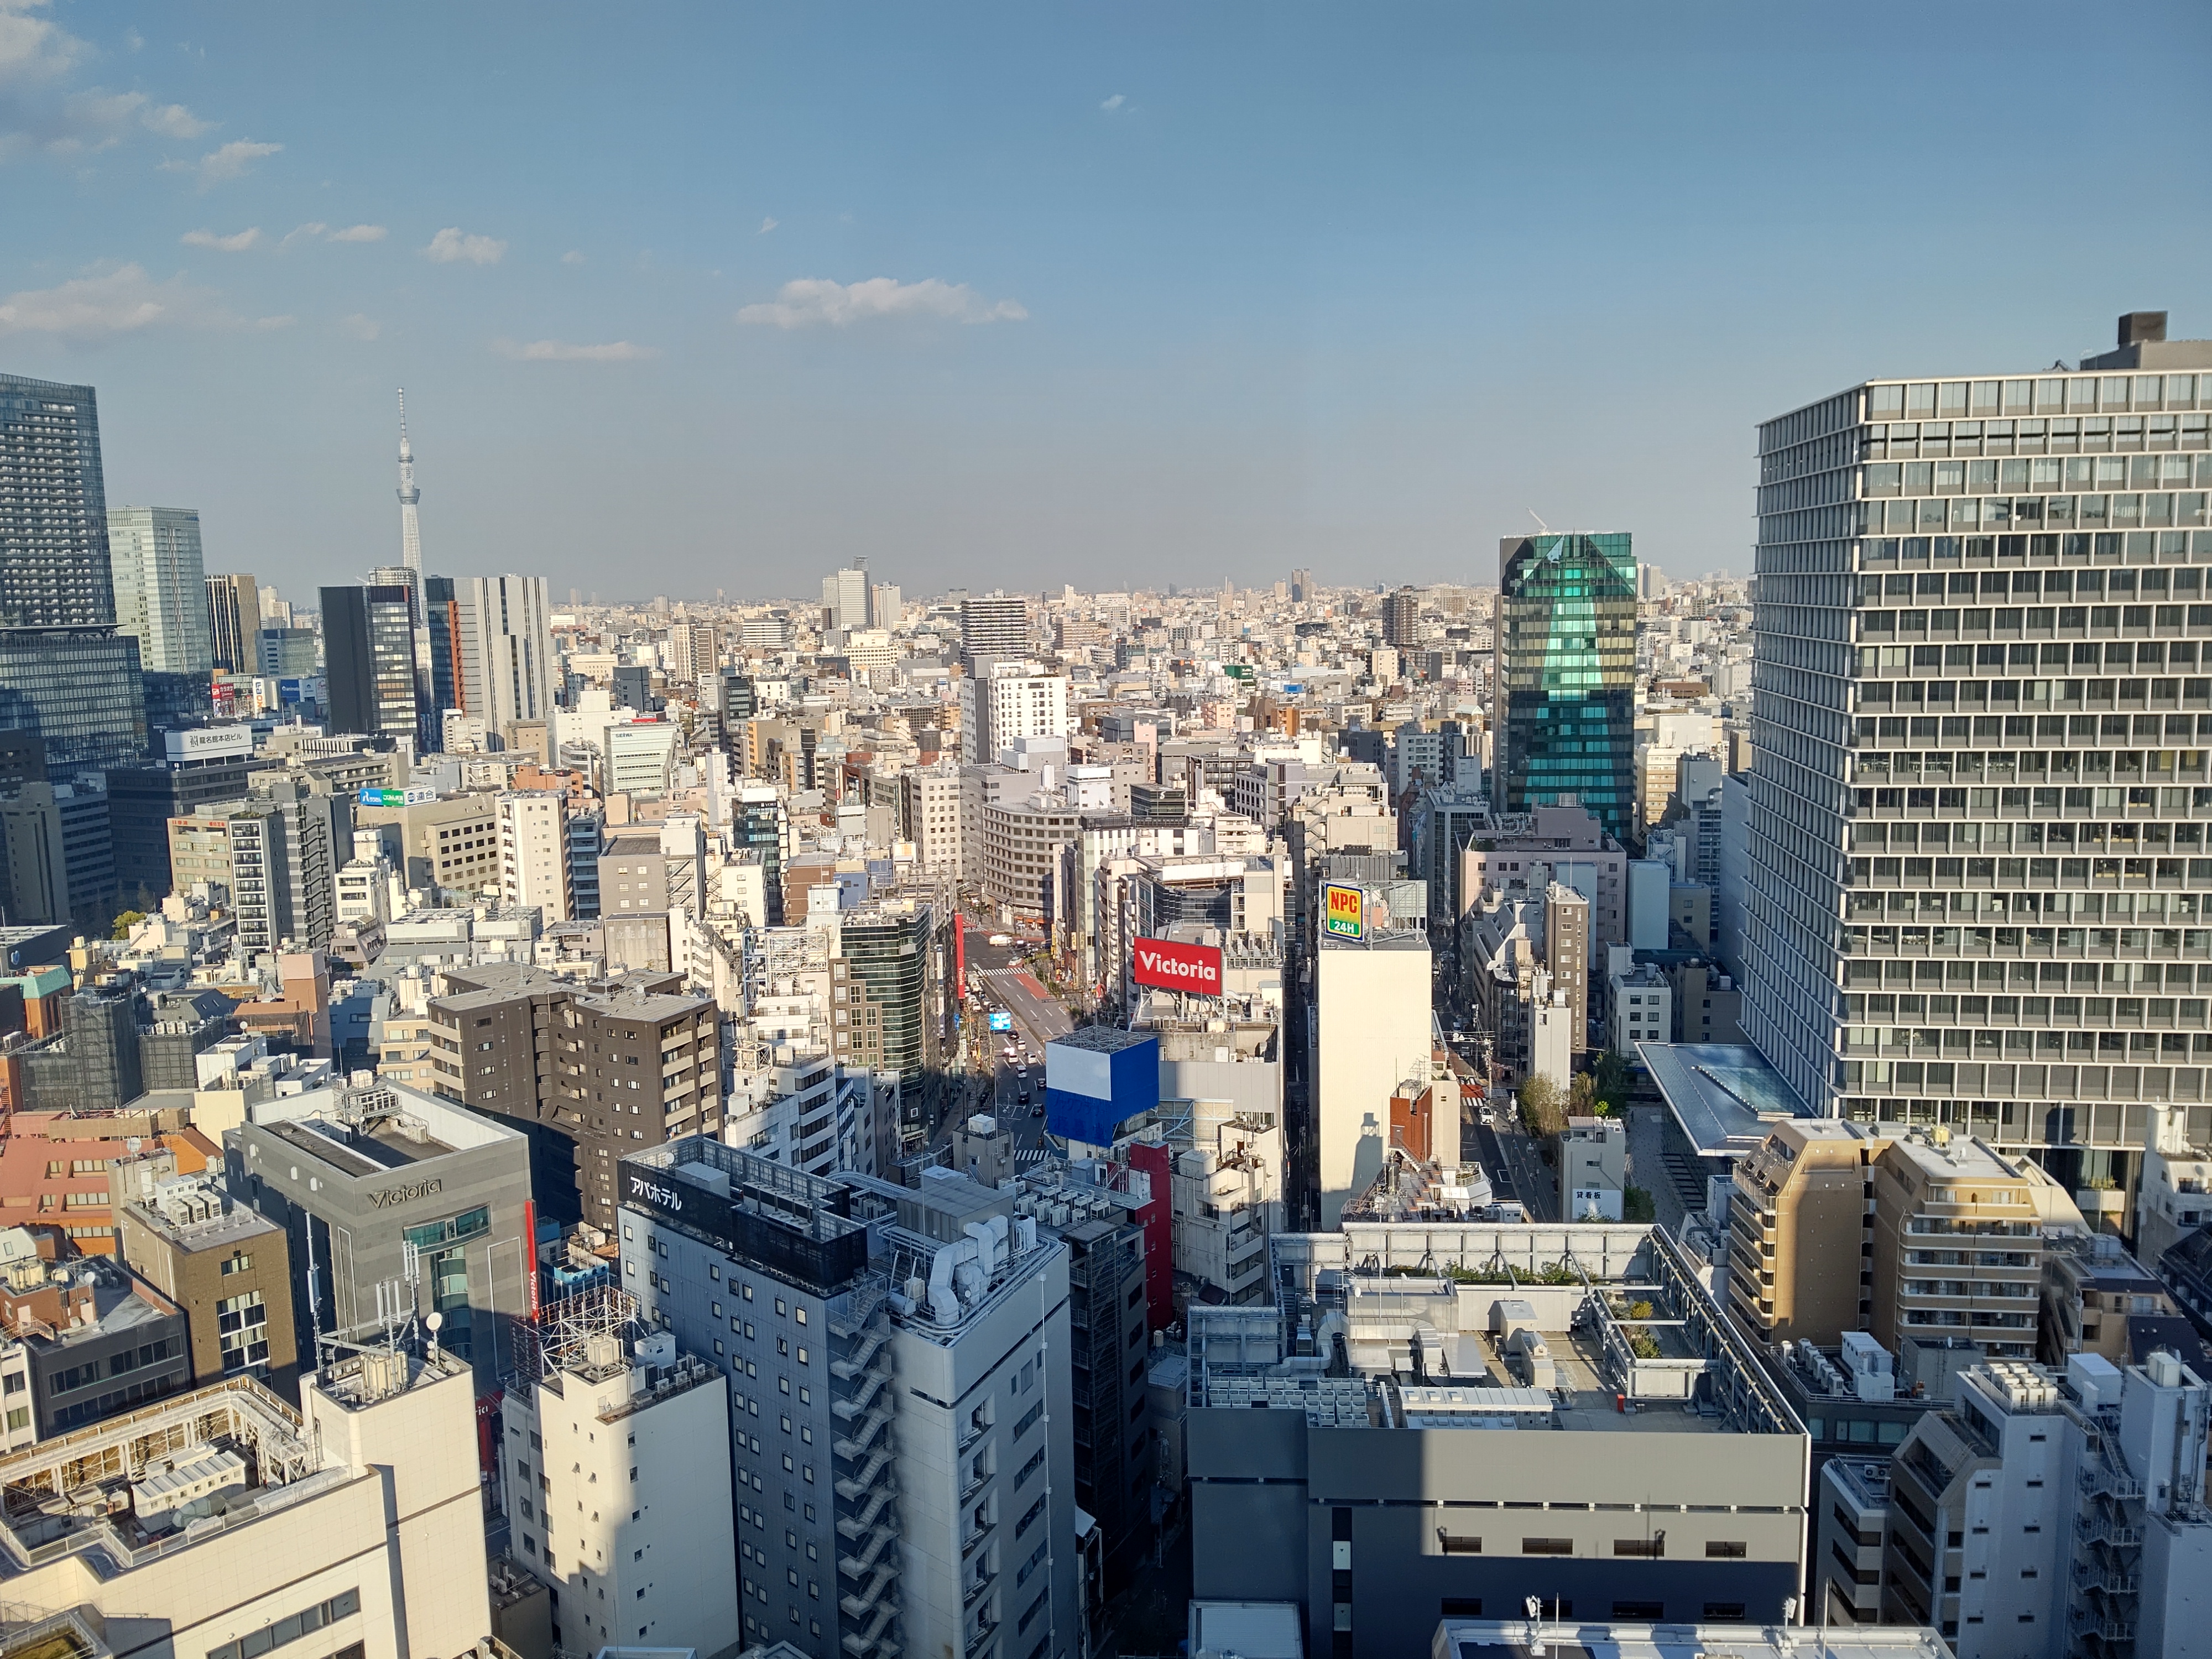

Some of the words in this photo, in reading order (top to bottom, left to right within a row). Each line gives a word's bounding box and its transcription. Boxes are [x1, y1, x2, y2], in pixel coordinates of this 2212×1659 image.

[199, 733, 243, 744] 龍名館本店ビル
[416, 790, 434, 801] 連合
[1331, 891, 1357, 914] NPC
[1334, 921, 1354, 933] 24H
[1139, 950, 1215, 980] Victoria
[367, 1178, 441, 1208] Victoria
[630, 1176, 682, 1211] アパホテル
[1576, 1191, 1601, 1199] 貸看板
[530, 1271, 538, 1310] Victoria
